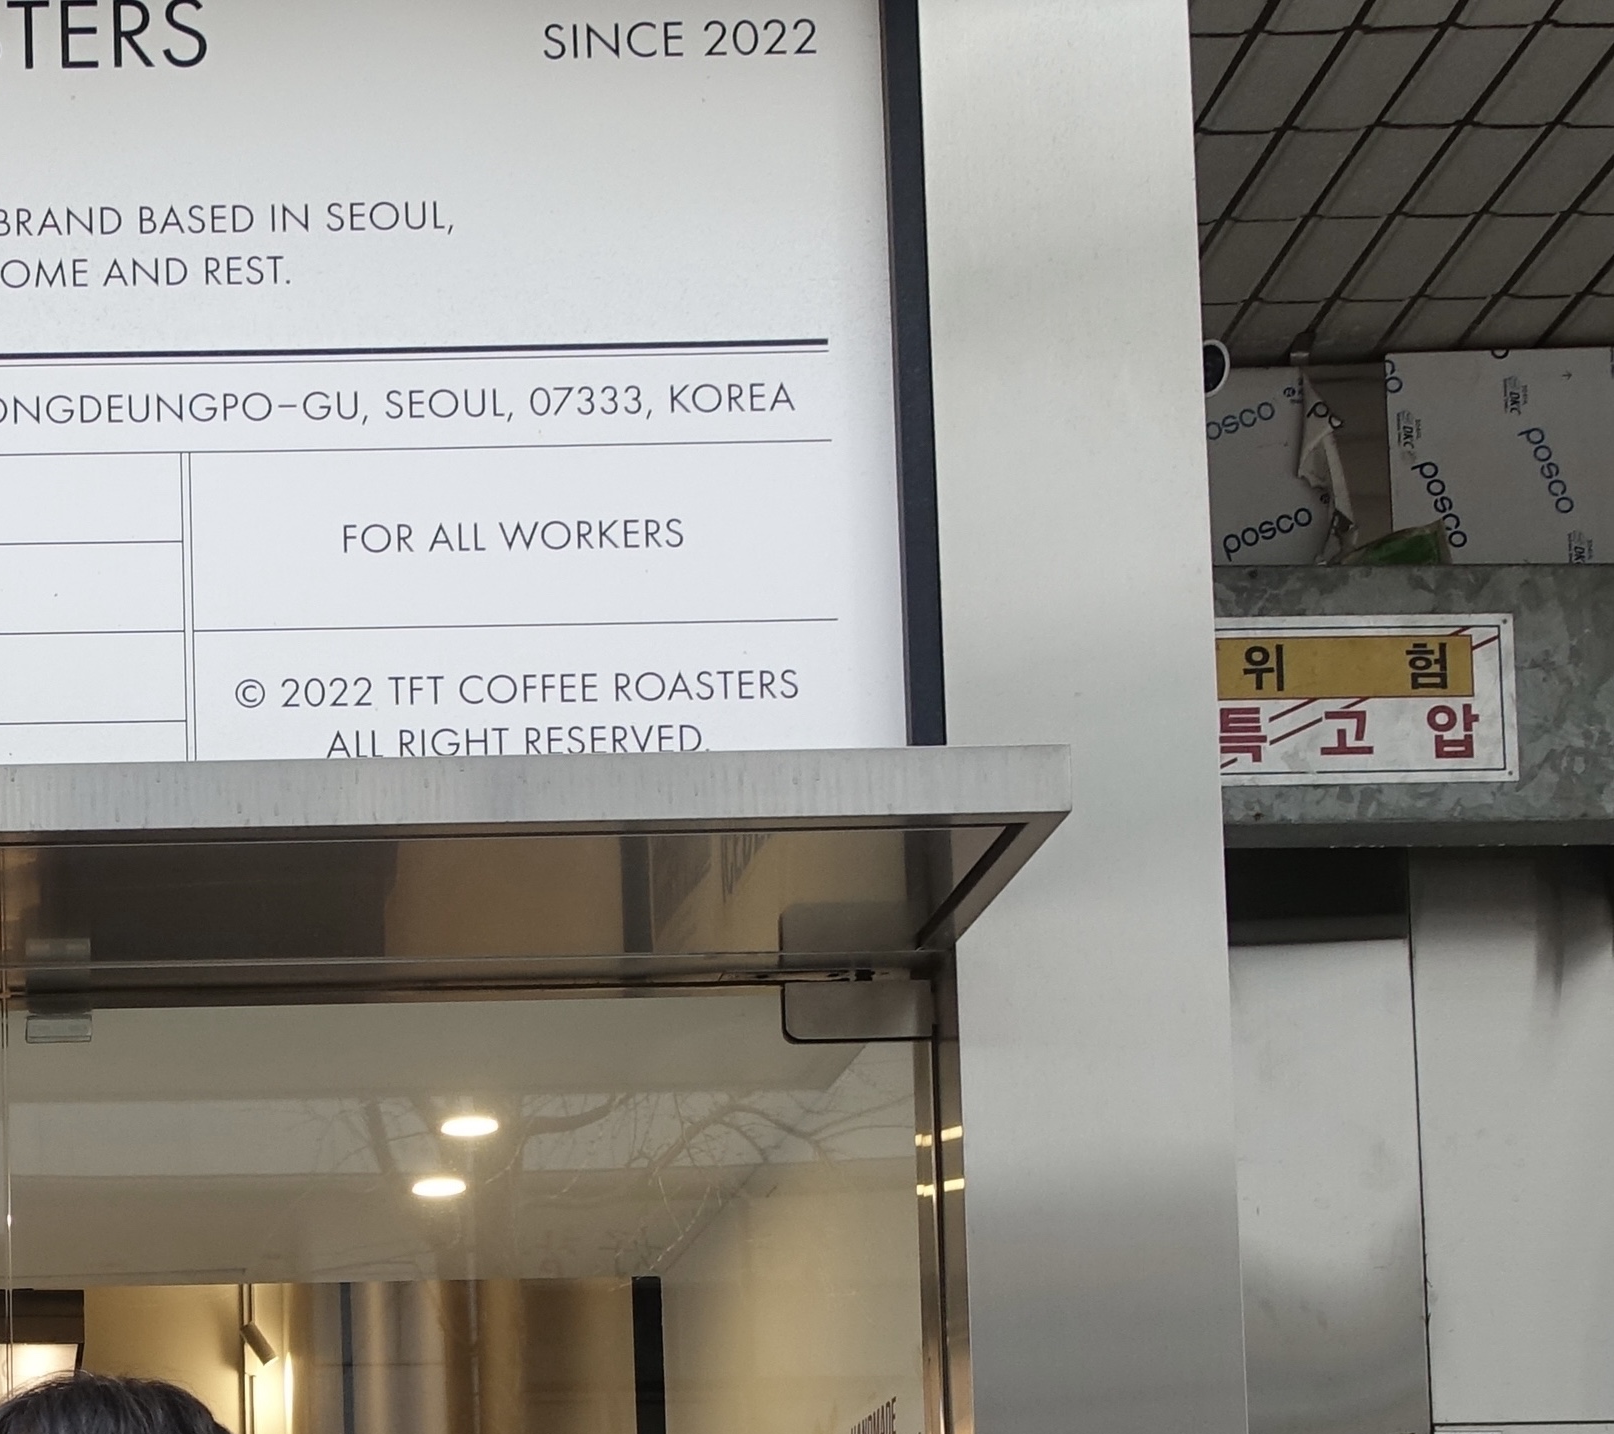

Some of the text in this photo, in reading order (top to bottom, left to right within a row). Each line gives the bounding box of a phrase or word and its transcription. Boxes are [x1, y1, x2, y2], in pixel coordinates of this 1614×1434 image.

[544, 19, 816, 60] SINCE 2022
[139, 205, 254, 234] BASED
[271, 204, 309, 232] IN
[327, 201, 453, 235] SEOUL,
[103, 258, 187, 286] AND
[205, 256, 290, 285] REST.
[385, 388, 513, 422] SEOUL,
[530, 385, 652, 420] 07333,
[670, 382, 795, 413] KOREA
[1207, 401, 1275, 440] osco
[1518, 426, 1574, 514] posco
[1411, 461, 1468, 548] posco
[343, 518, 683, 553] FOR ALL WORKERS
[1222, 507, 1313, 561] posco
[281, 677, 372, 707] 2022
[388, 676, 444, 705] TFT
[459, 673, 598, 704] COFFEE
[615, 669, 798, 701] ROASTERS
[327, 730, 382, 758] ALL
[399, 728, 509, 757] RIGHT
